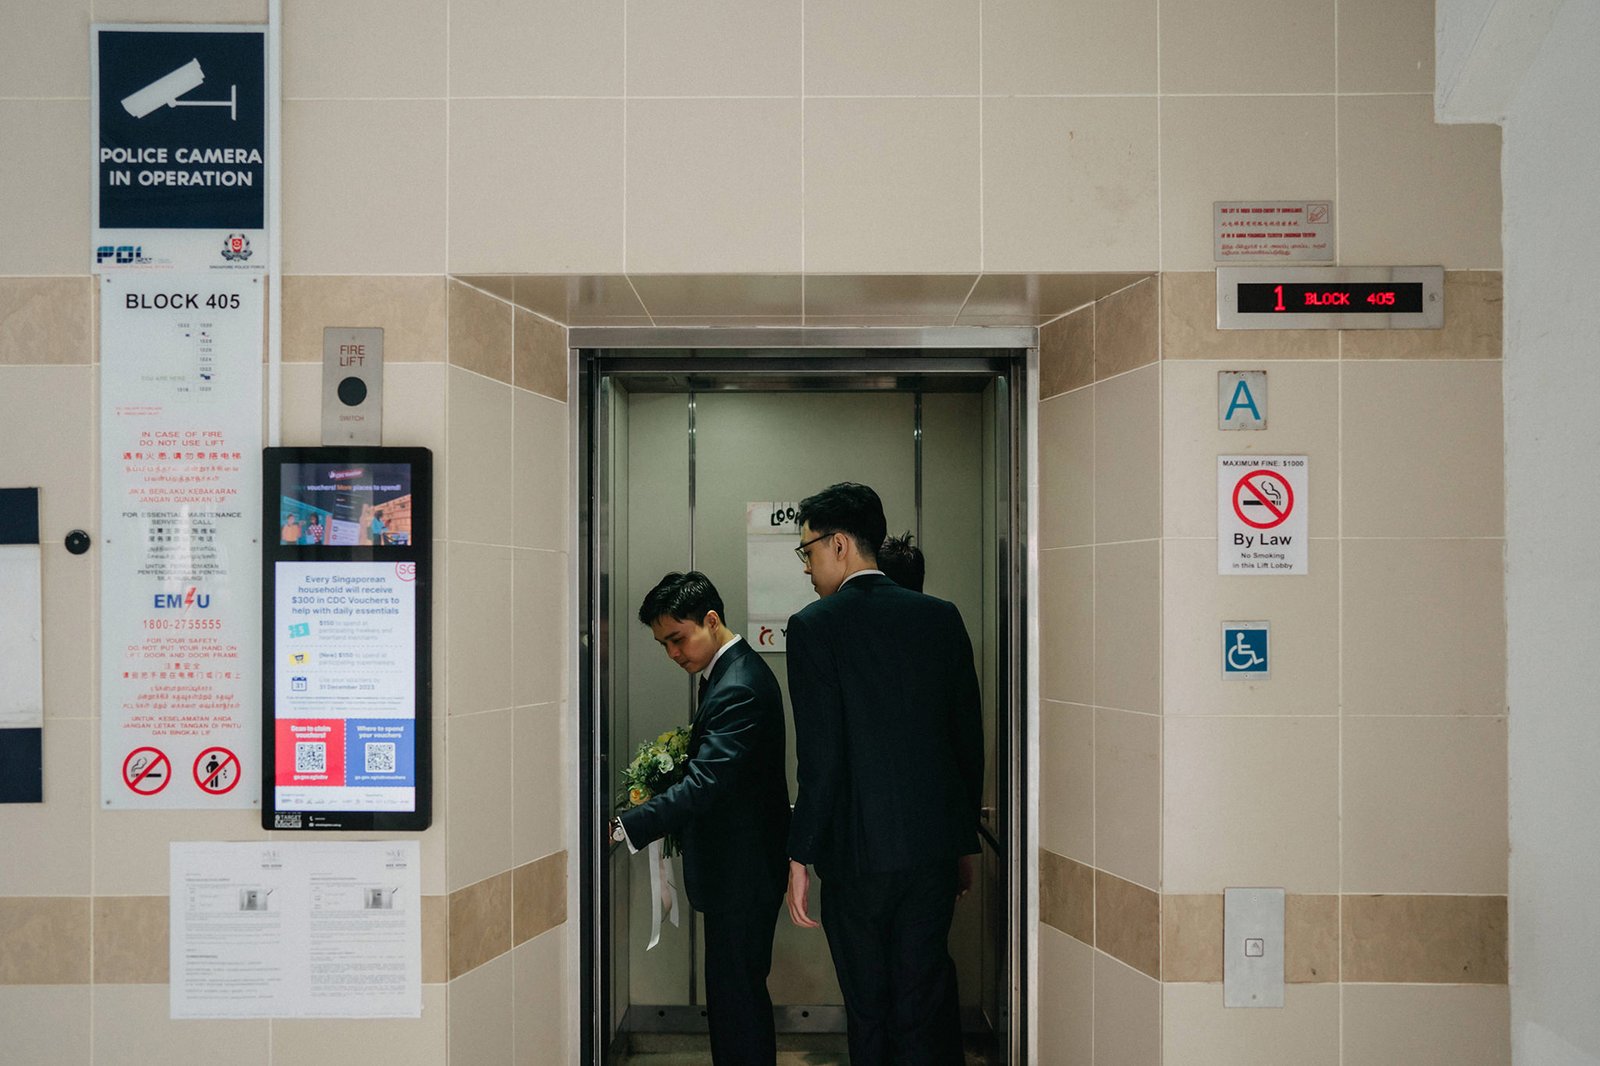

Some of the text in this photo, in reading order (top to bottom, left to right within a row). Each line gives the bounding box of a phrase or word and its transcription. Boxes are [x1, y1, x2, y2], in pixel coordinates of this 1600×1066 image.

[100, 148, 262, 164] POLICE CAMERA
[110, 170, 252, 186] IN OPERATION
[126, 294, 240, 309] BLOCK 405
[1273, 285, 1396, 311] 1 BLOCK 405
[340, 345, 365, 355] FIRE
[340, 357, 365, 366] LIFT
[1225, 380, 1261, 420] A
[1234, 533, 1292, 548] By Law
[305, 576, 385, 584] Every Singaporean
[144, 619, 222, 629] 1800-2755555
